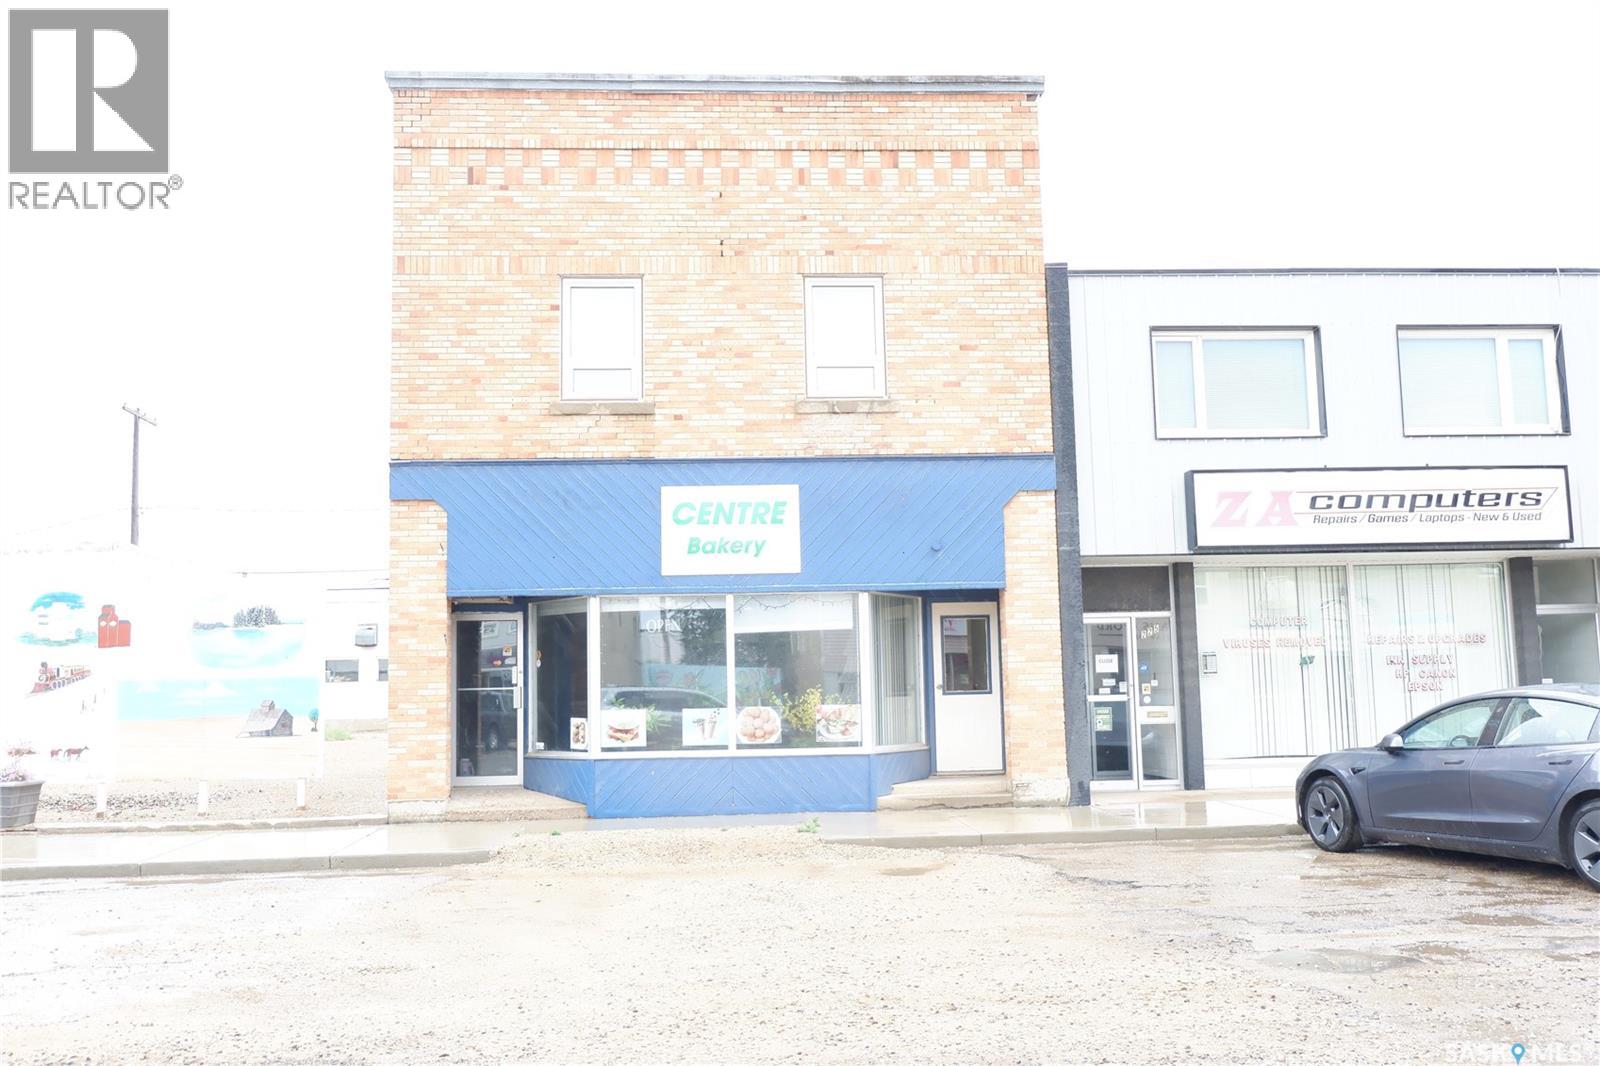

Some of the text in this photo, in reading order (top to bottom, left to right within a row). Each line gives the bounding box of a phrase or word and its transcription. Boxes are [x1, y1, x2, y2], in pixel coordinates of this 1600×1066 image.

[1309, 490, 1543, 513] computers
[671, 500, 787, 526] CENTRE
[1312, 514, 1358, 525] Repairs
[1367, 513, 1409, 524] Games
[1419, 512, 1465, 524] Laptops
[1473, 511, 1499, 522] New
[1512, 511, 1542, 522] Used
[687, 537, 767, 557] Bakery
[1222, 637, 1271, 649] VIRUSES
[1411, 654, 1454, 665] SUPPLY
[1418, 668, 1456, 679] CANON
[1407, 681, 1443, 692] EPSON
